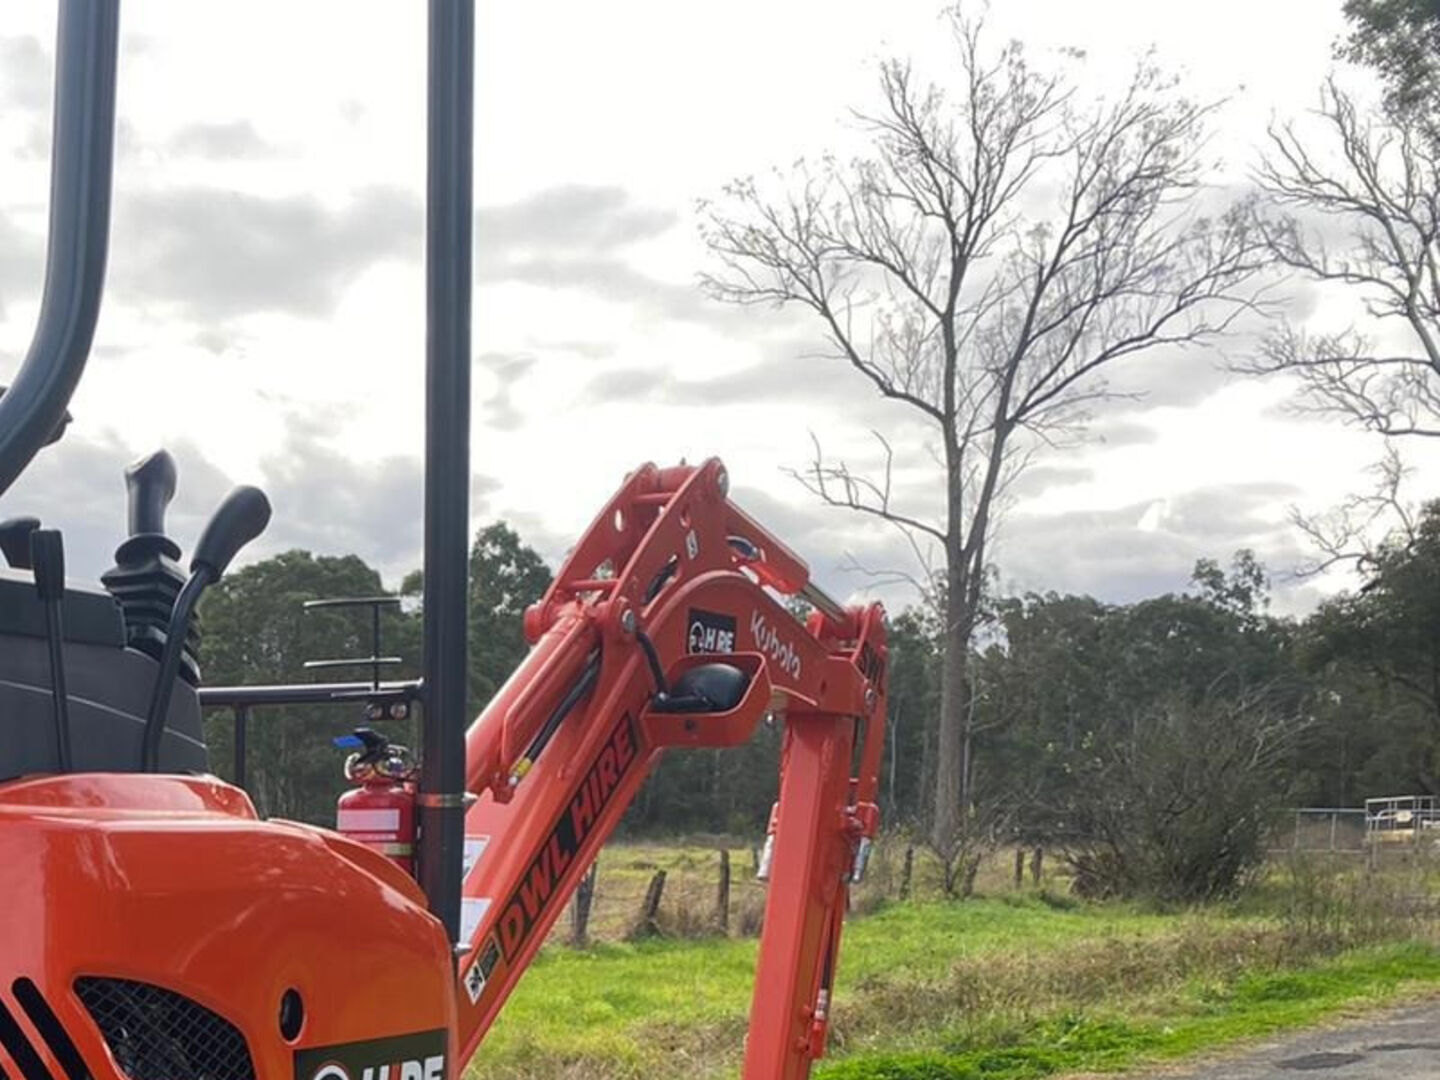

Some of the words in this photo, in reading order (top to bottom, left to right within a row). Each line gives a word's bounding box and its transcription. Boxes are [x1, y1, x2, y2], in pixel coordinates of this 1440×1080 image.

[705, 628, 734, 654] HRE
[750, 609, 801, 680] Kubota
[499, 830, 570, 960] DWL
[571, 717, 634, 843] HIRE
